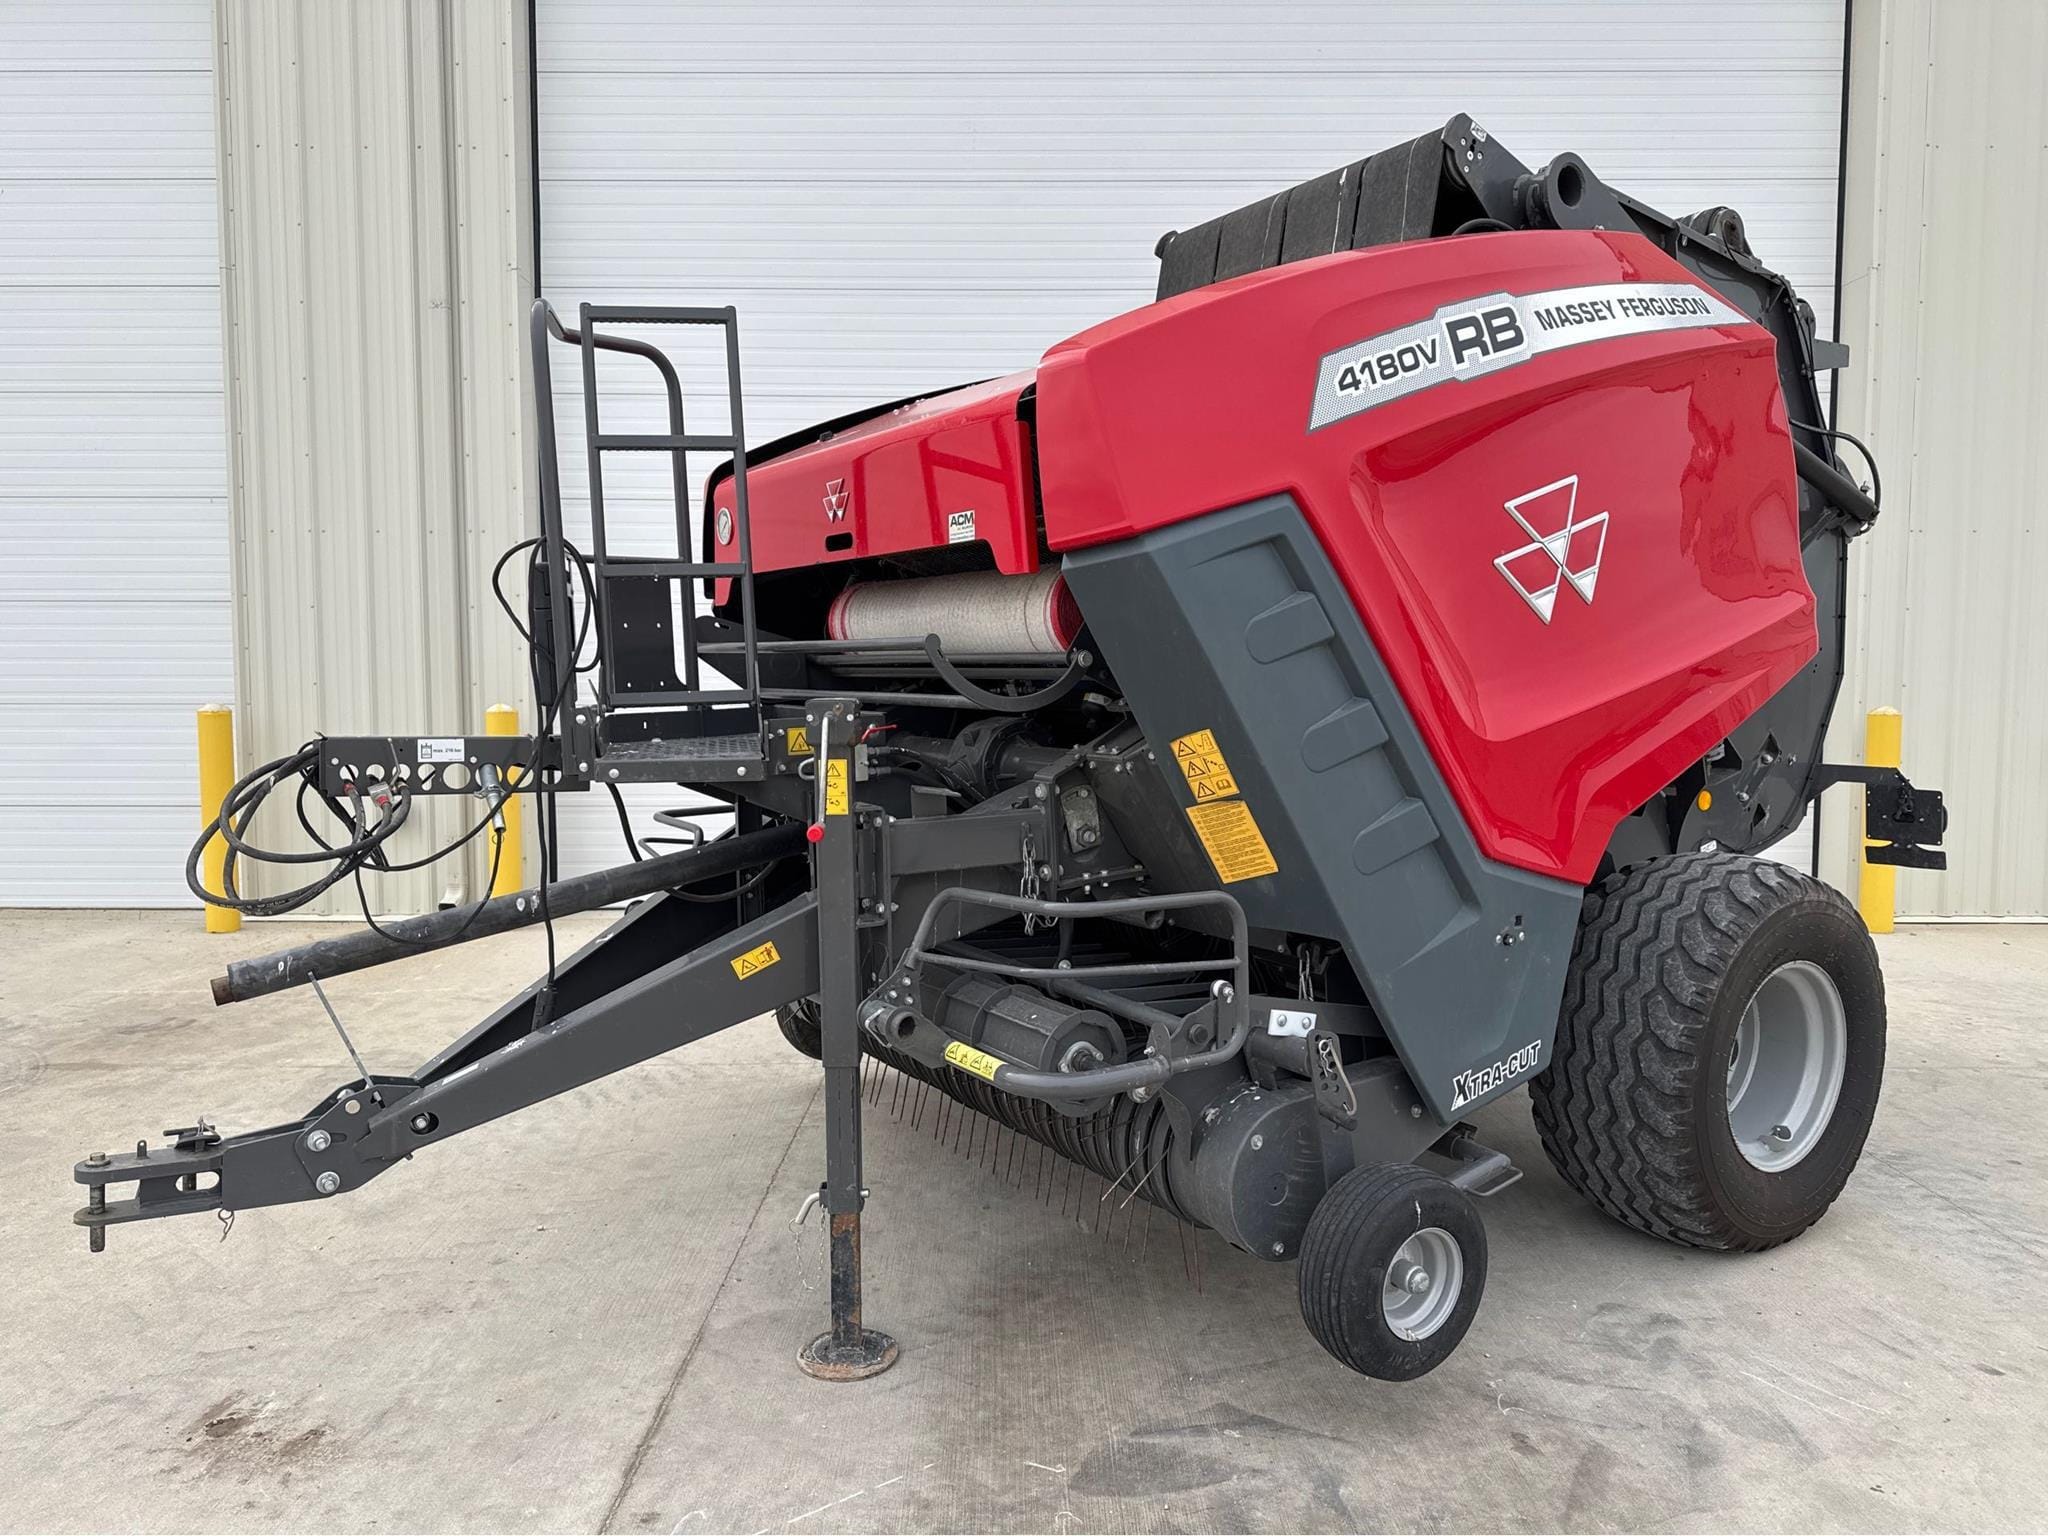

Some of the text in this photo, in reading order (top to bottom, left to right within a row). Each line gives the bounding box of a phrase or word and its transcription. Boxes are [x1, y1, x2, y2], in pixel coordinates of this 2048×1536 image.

[1337, 298, 1711, 391] 4180V RB MASSEY FERGUSON
[950, 512, 974, 527] ACM
[1450, 1039, 1542, 1112] XTRA-CUT
